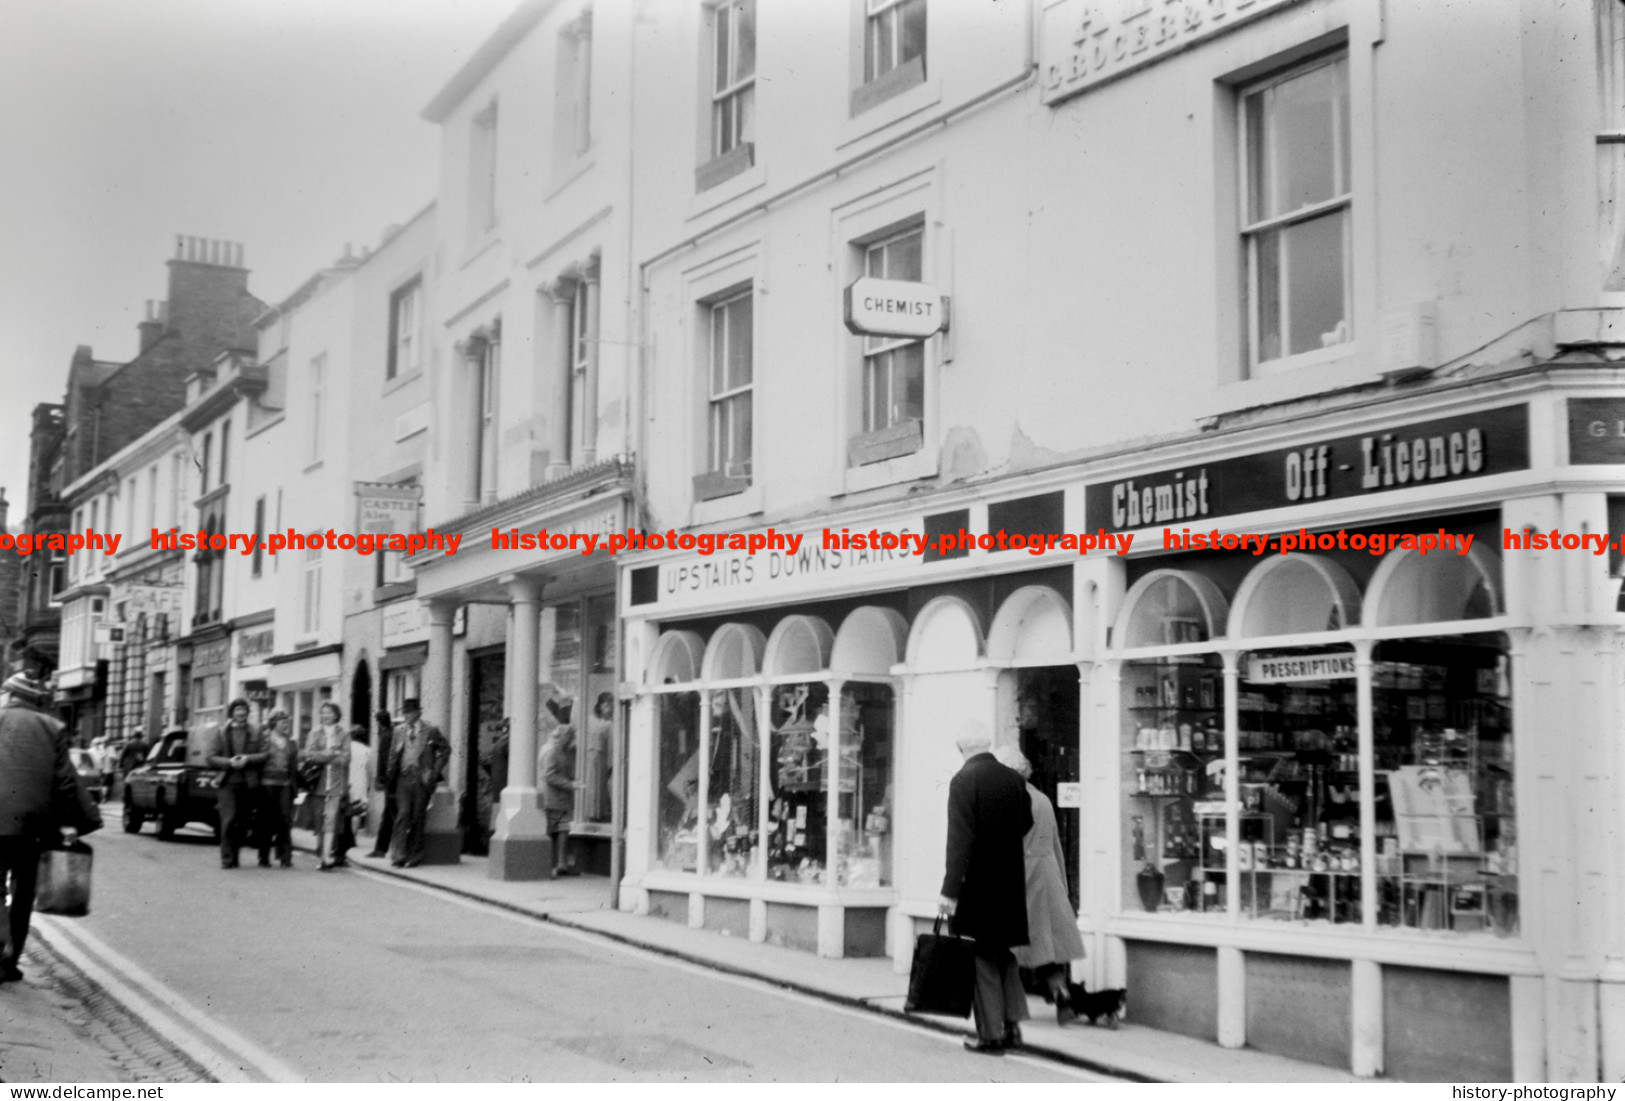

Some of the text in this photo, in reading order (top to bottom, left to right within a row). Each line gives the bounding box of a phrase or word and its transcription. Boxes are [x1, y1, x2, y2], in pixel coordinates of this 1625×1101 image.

[864, 297, 933, 316] CHEMIST
[1112, 468, 1208, 528] Chemist
[1286, 445, 1328, 500] Off
[1361, 428, 1483, 489] Licence
[363, 499, 415, 511] CASTLE
[363, 510, 390, 520] Ales
[667, 556, 755, 594] UPSTAIRS
[1262, 657, 1356, 679] PRESCRIPTIONS
